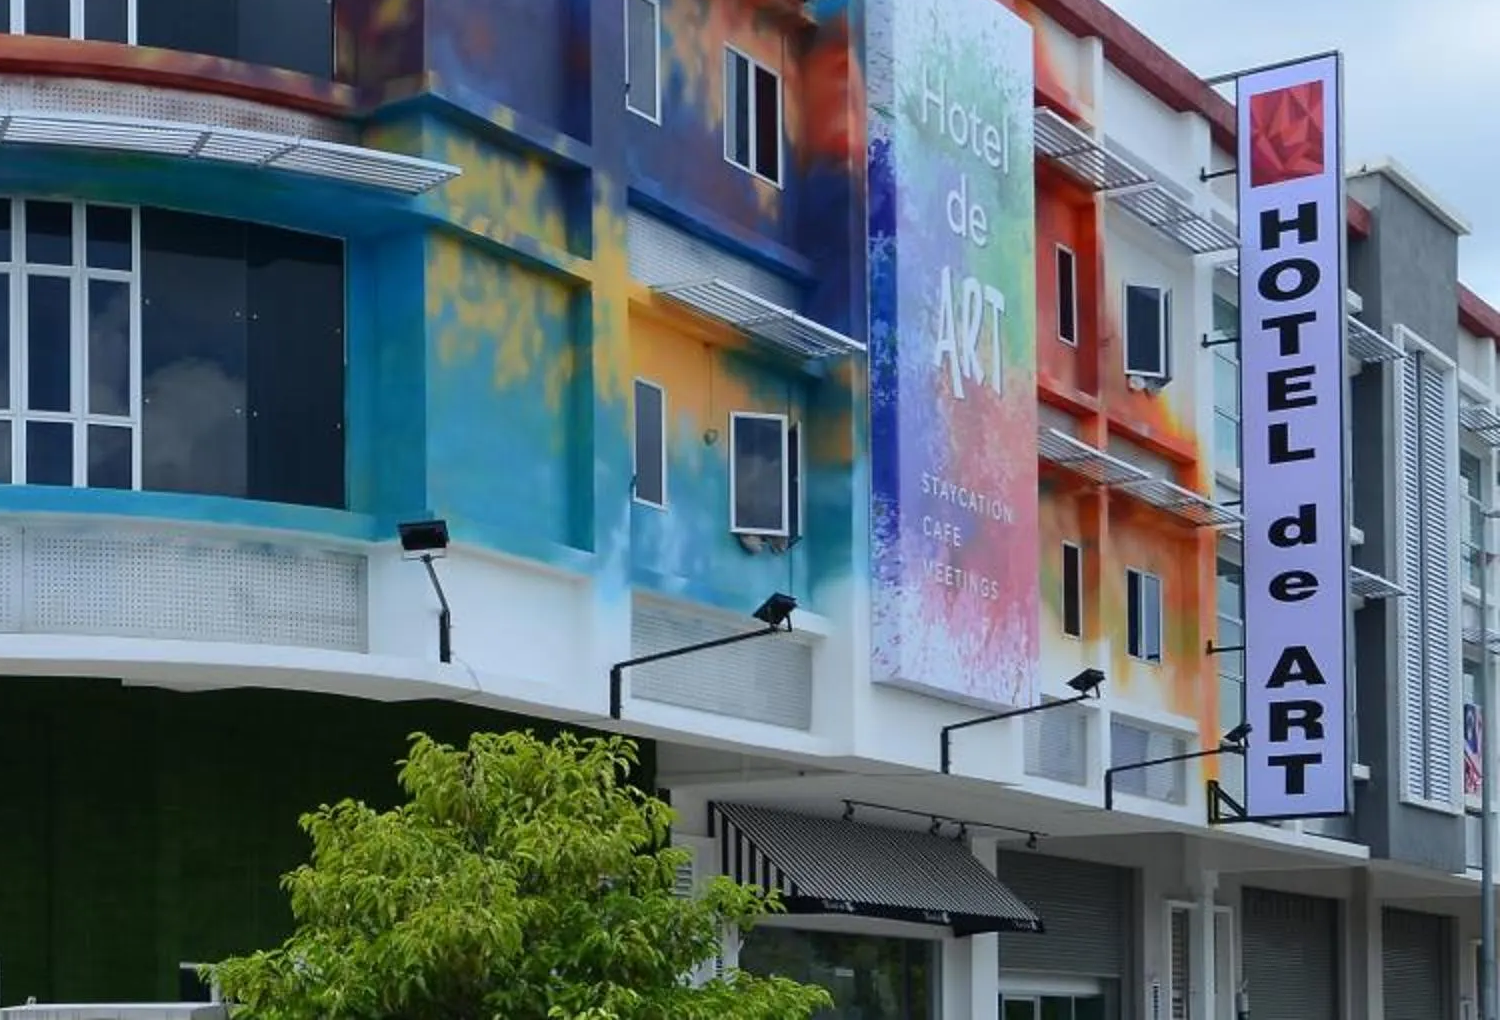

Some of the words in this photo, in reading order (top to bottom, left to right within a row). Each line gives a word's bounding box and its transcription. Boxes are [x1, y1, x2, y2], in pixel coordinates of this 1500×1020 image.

[920, 64, 1010, 175] Hotel
[946, 174, 988, 247] de
[933, 265, 1006, 399] ART
[1257, 200, 1321, 465] HOTEL
[920, 471, 1014, 525] STAYCATION
[922, 515, 962, 547] CAFE
[922, 559, 999, 600] MEETINGS
[1267, 503, 1320, 602] de
[1265, 645, 1327, 795] ART
